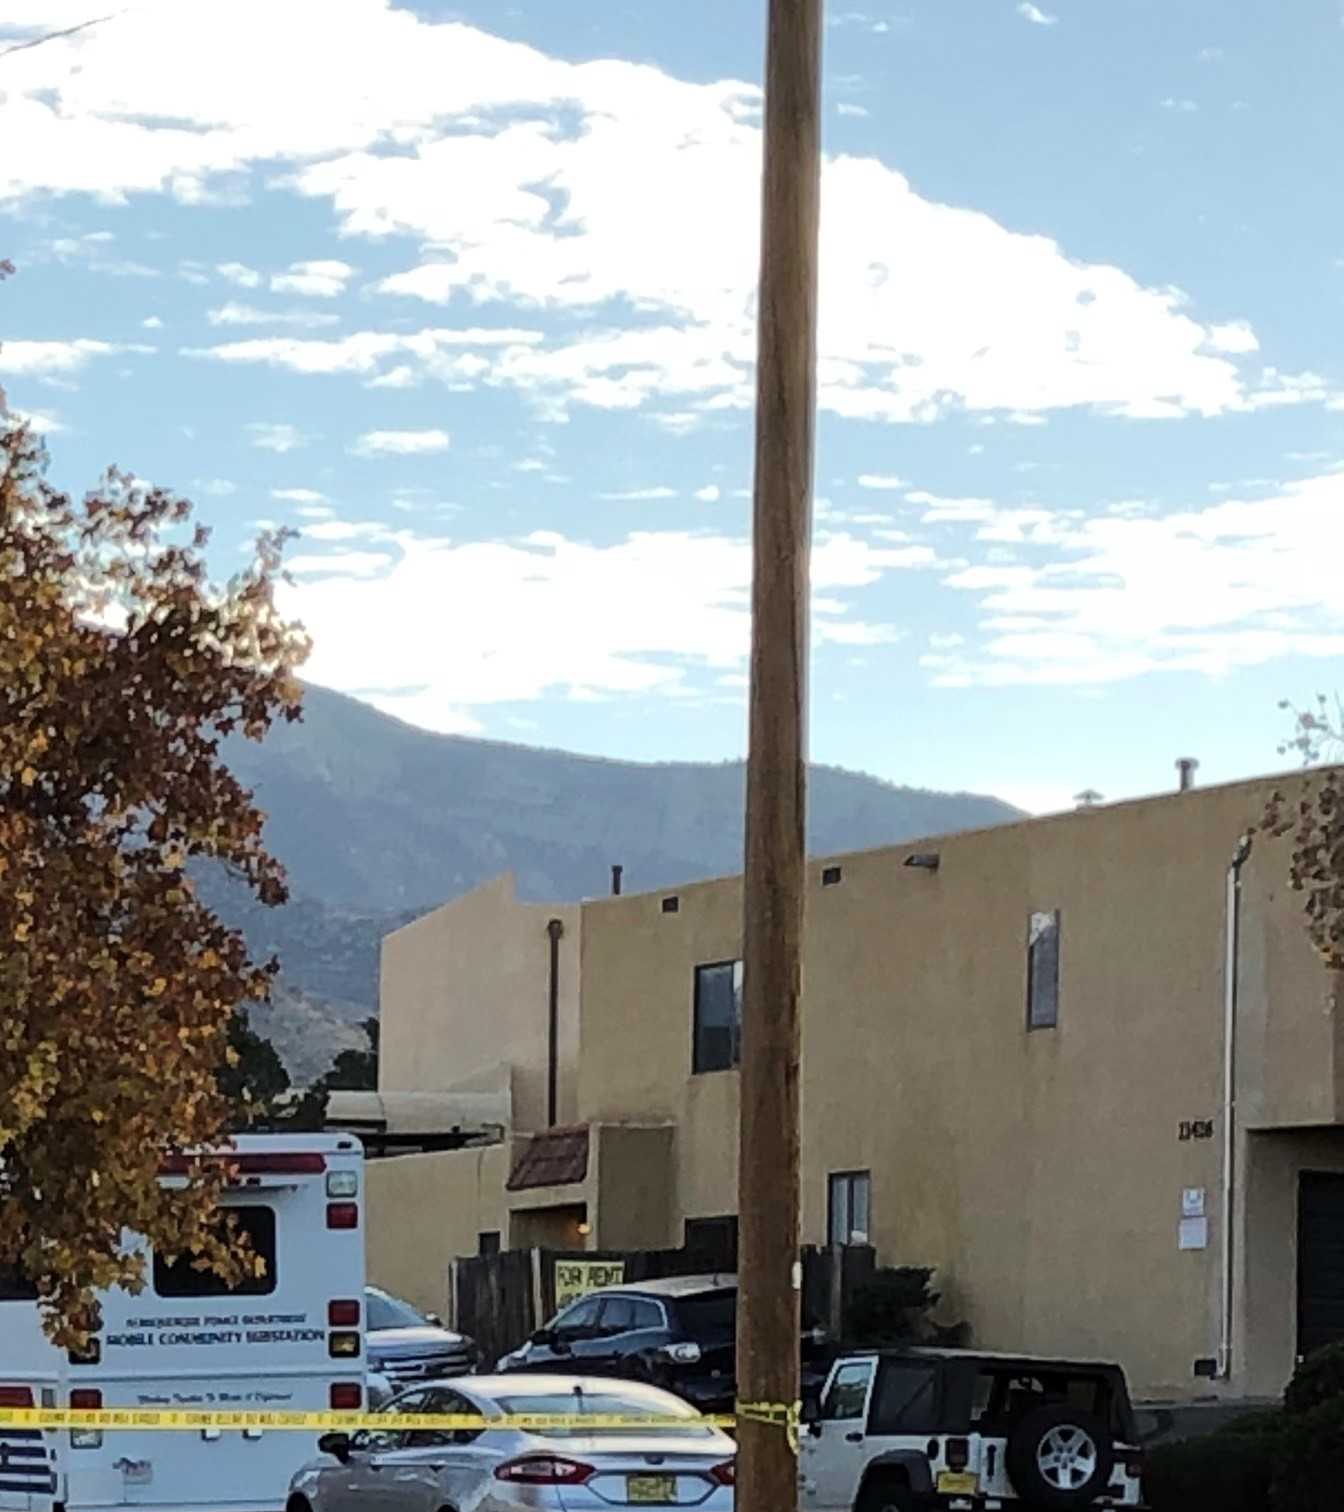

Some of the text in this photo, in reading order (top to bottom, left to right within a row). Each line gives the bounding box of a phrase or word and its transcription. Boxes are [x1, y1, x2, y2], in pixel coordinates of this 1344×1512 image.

[557, 1265, 624, 1287] FOR RENT
[106, 1329, 325, 1346] MOBILE COMMUNITY SUBSTATION
